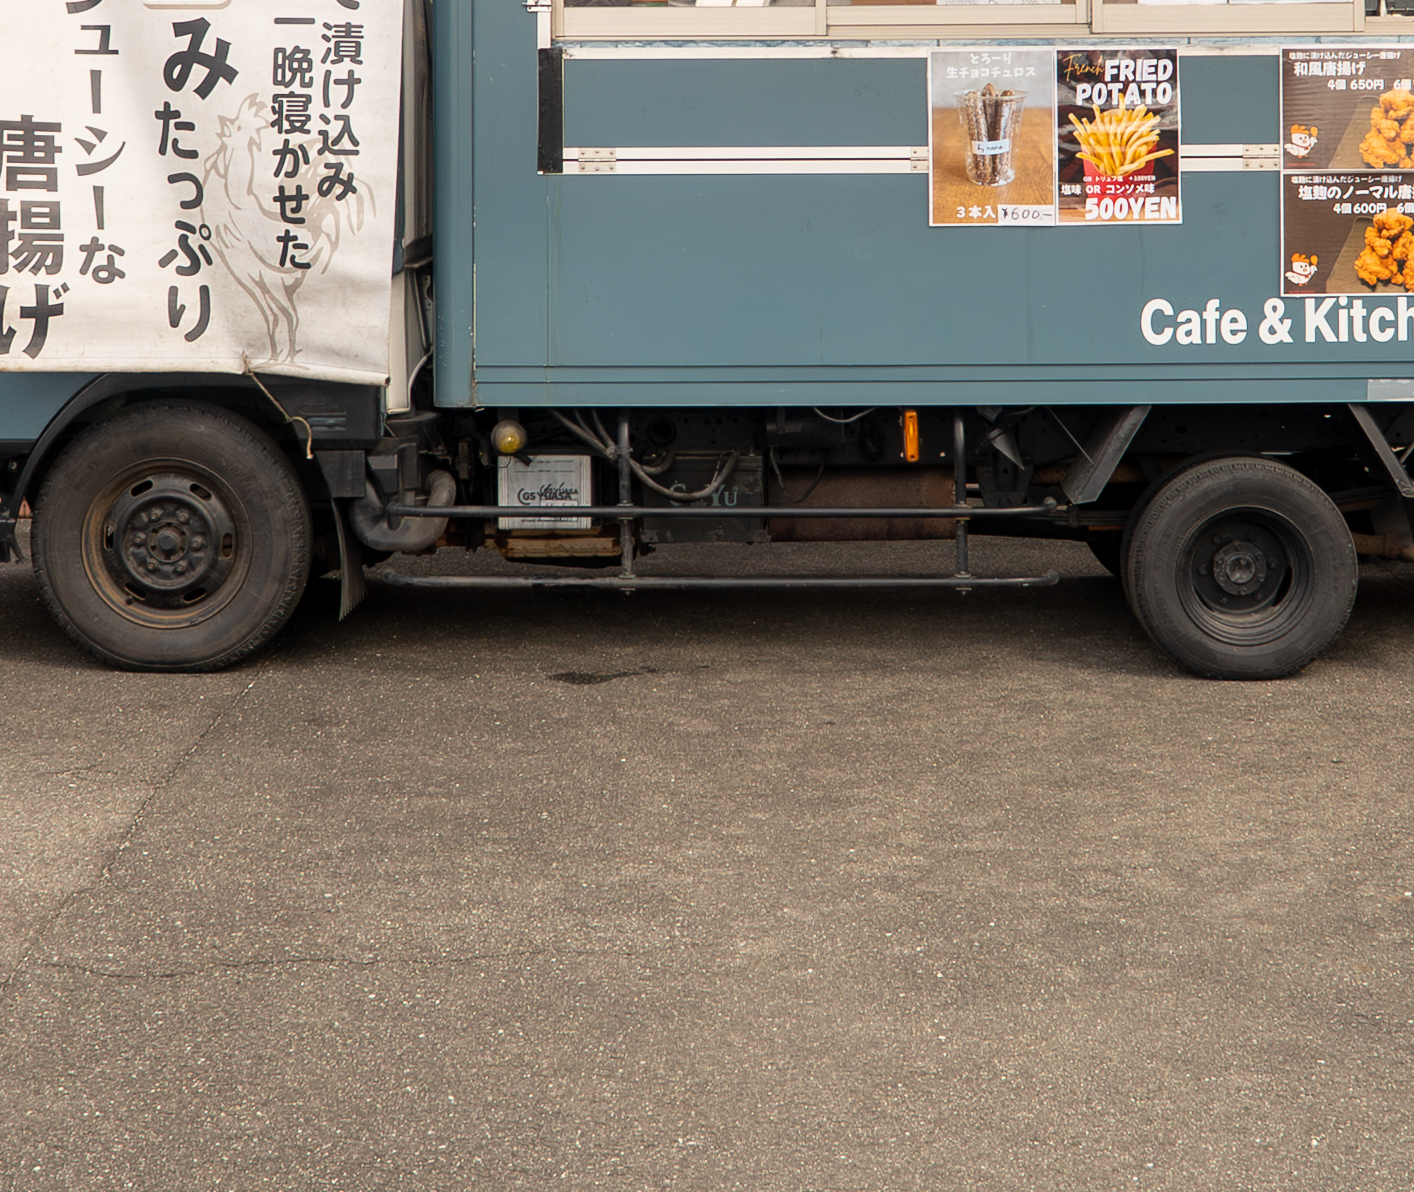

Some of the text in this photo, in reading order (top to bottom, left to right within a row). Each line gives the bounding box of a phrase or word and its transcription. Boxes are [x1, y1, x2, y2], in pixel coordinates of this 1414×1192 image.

[970, 52, 1012, 65] とろーり
[1062, 53, 1174, 82] French FRIED
[1293, 61, 1366, 76] 和風唐揚げ
[947, 66, 1036, 79] 生チョコチュロス
[1075, 82, 1173, 106] POTATO
[318, 21, 365, 203] 漬け込み
[270, 16, 316, 271] 一晩寝かせた
[1061, 184, 1155, 195] 塩味 OR コンソメ味
[956, 205, 996, 219] 3本入
[1085, 196, 1177, 220] 500YEN
[1140, 298, 1248, 346] Cafe
[1258, 297, 1294, 345] &
